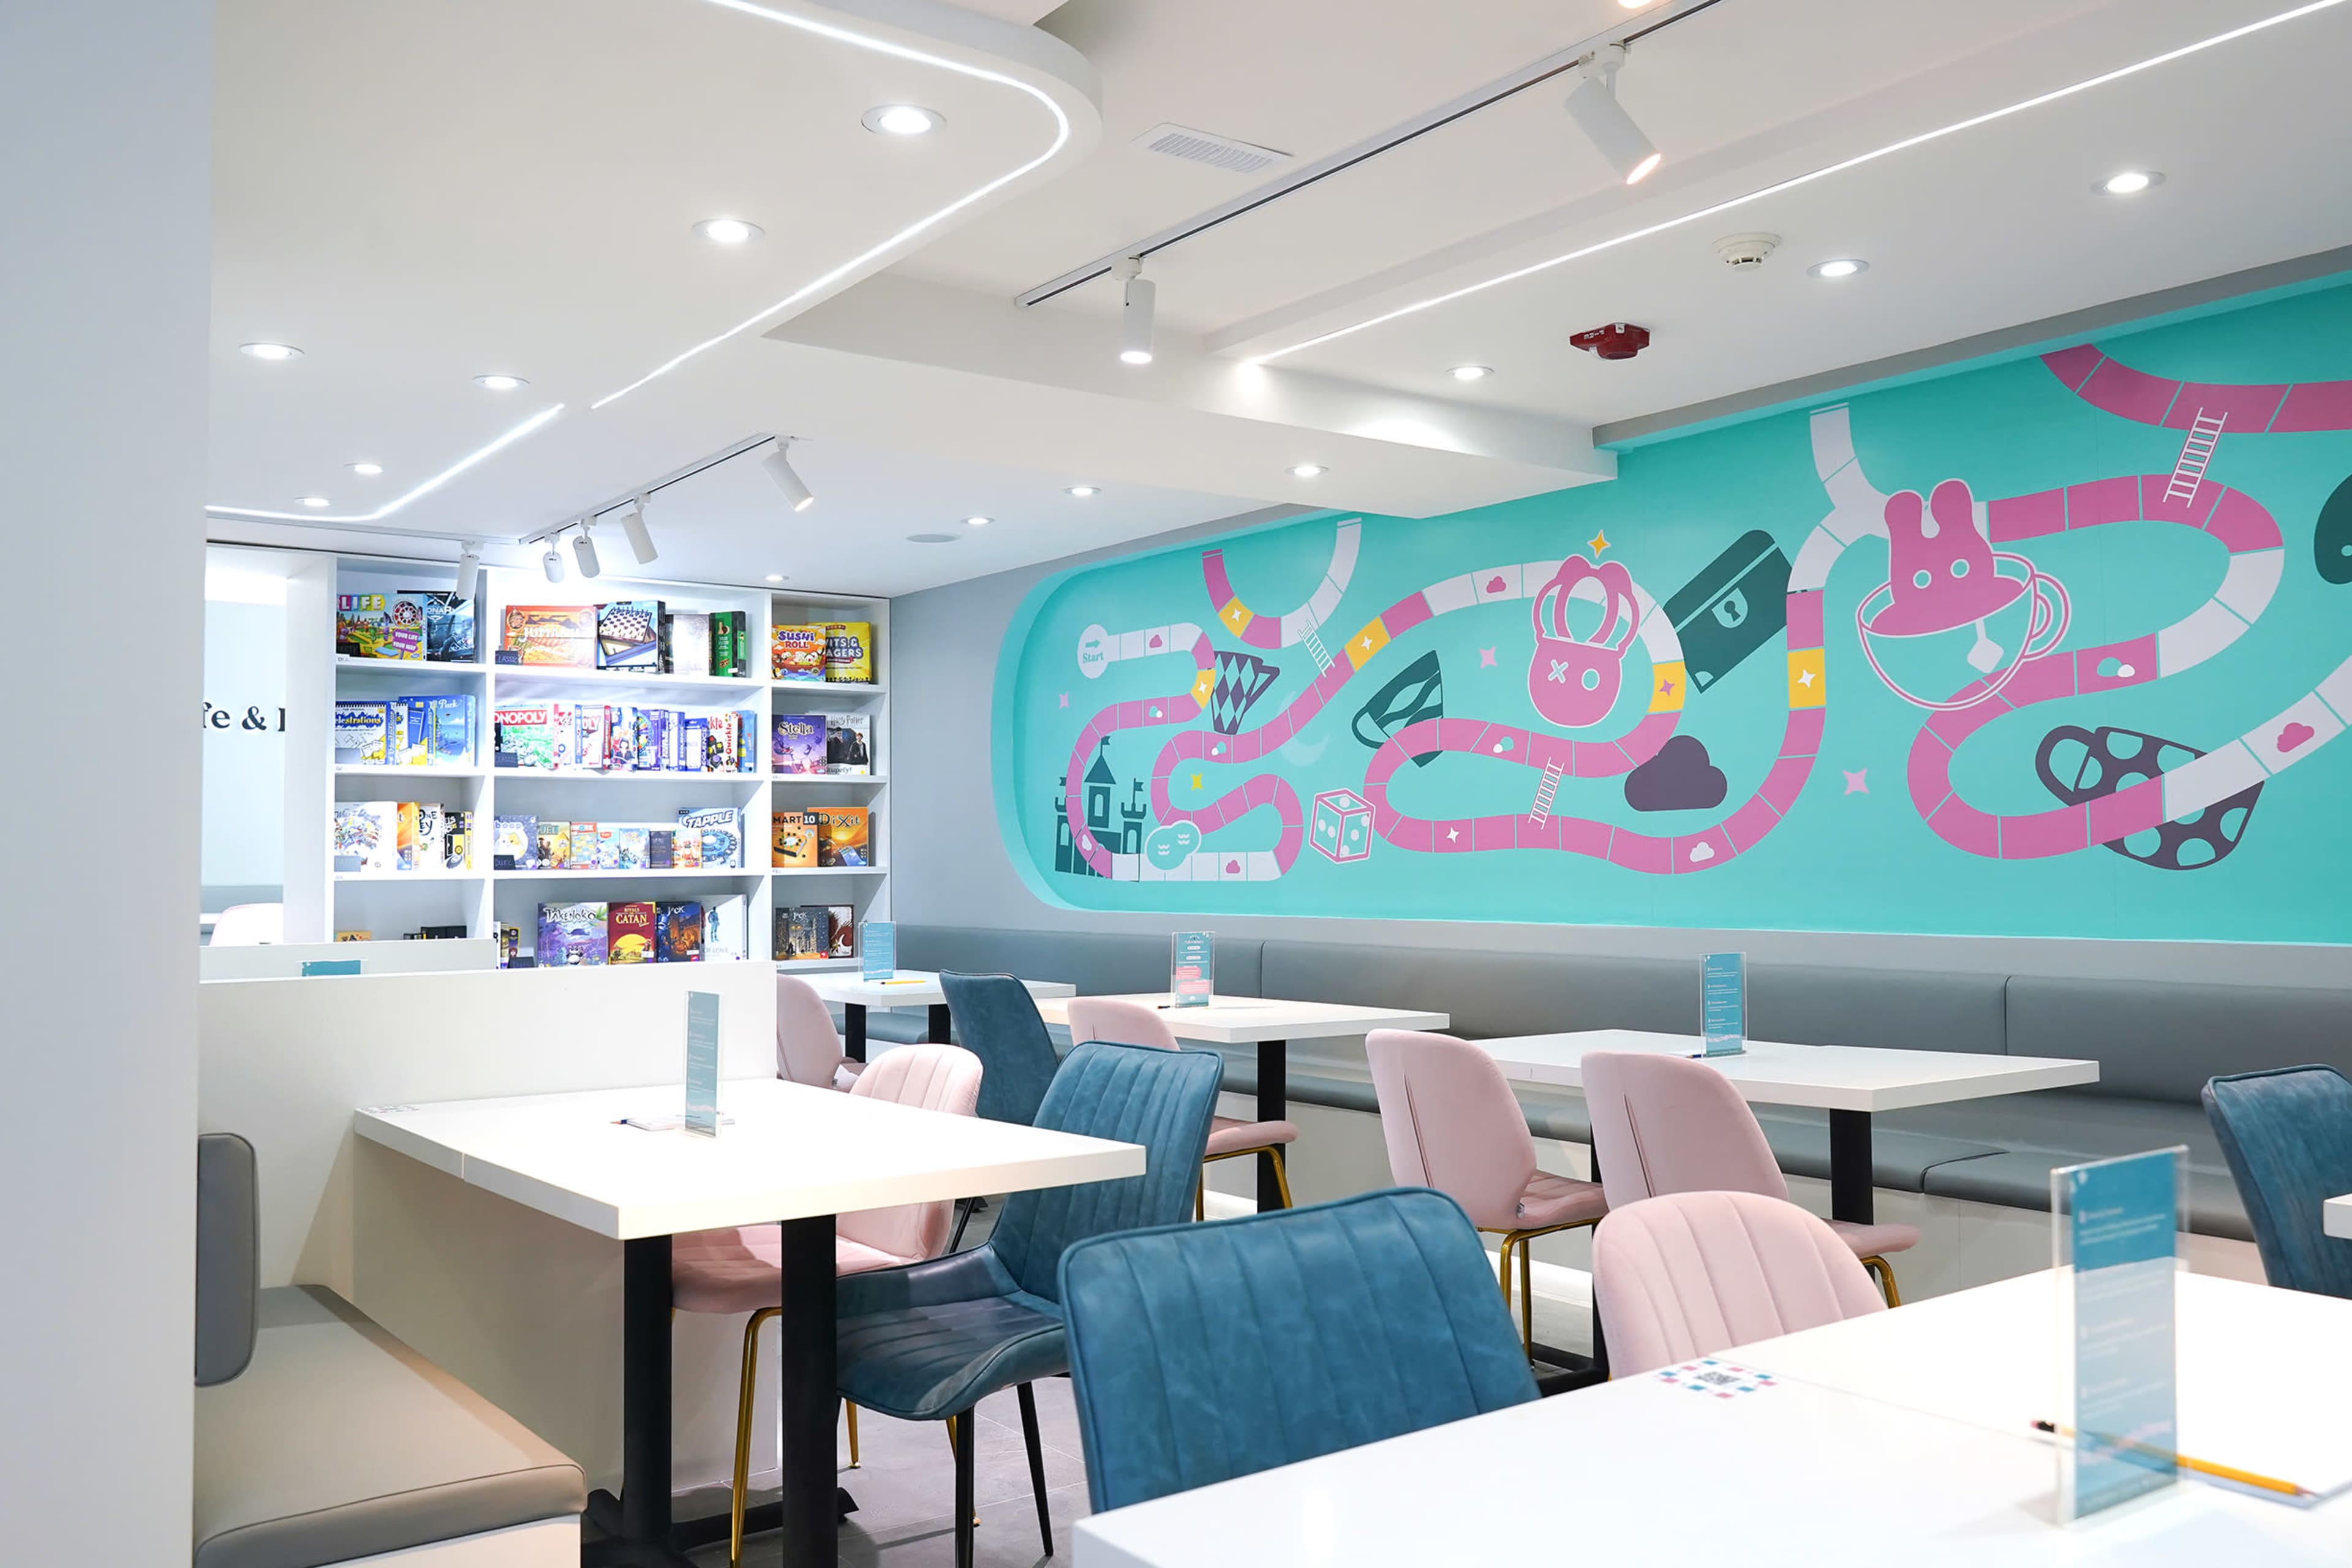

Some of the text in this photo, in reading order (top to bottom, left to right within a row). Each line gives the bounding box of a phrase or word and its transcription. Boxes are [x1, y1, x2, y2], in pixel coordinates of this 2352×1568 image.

[341, 595, 382, 610] LIFE
[394, 630, 408, 639] YOUR
[518, 627, 579, 643] JUMAN
[826, 648, 863, 657] AGERS
[1082, 653, 1104, 663] Start
[439, 698, 461, 709] Park
[203, 702, 230, 728] fe
[242, 706, 266, 731] &
[494, 711, 546, 724] ONOPOLY
[710, 716, 723, 729] kle
[778, 722, 813, 735] Stella
[685, 810, 733, 828] TAPPLE
[804, 815, 815, 824] 10
[616, 914, 647, 924] CATAN
